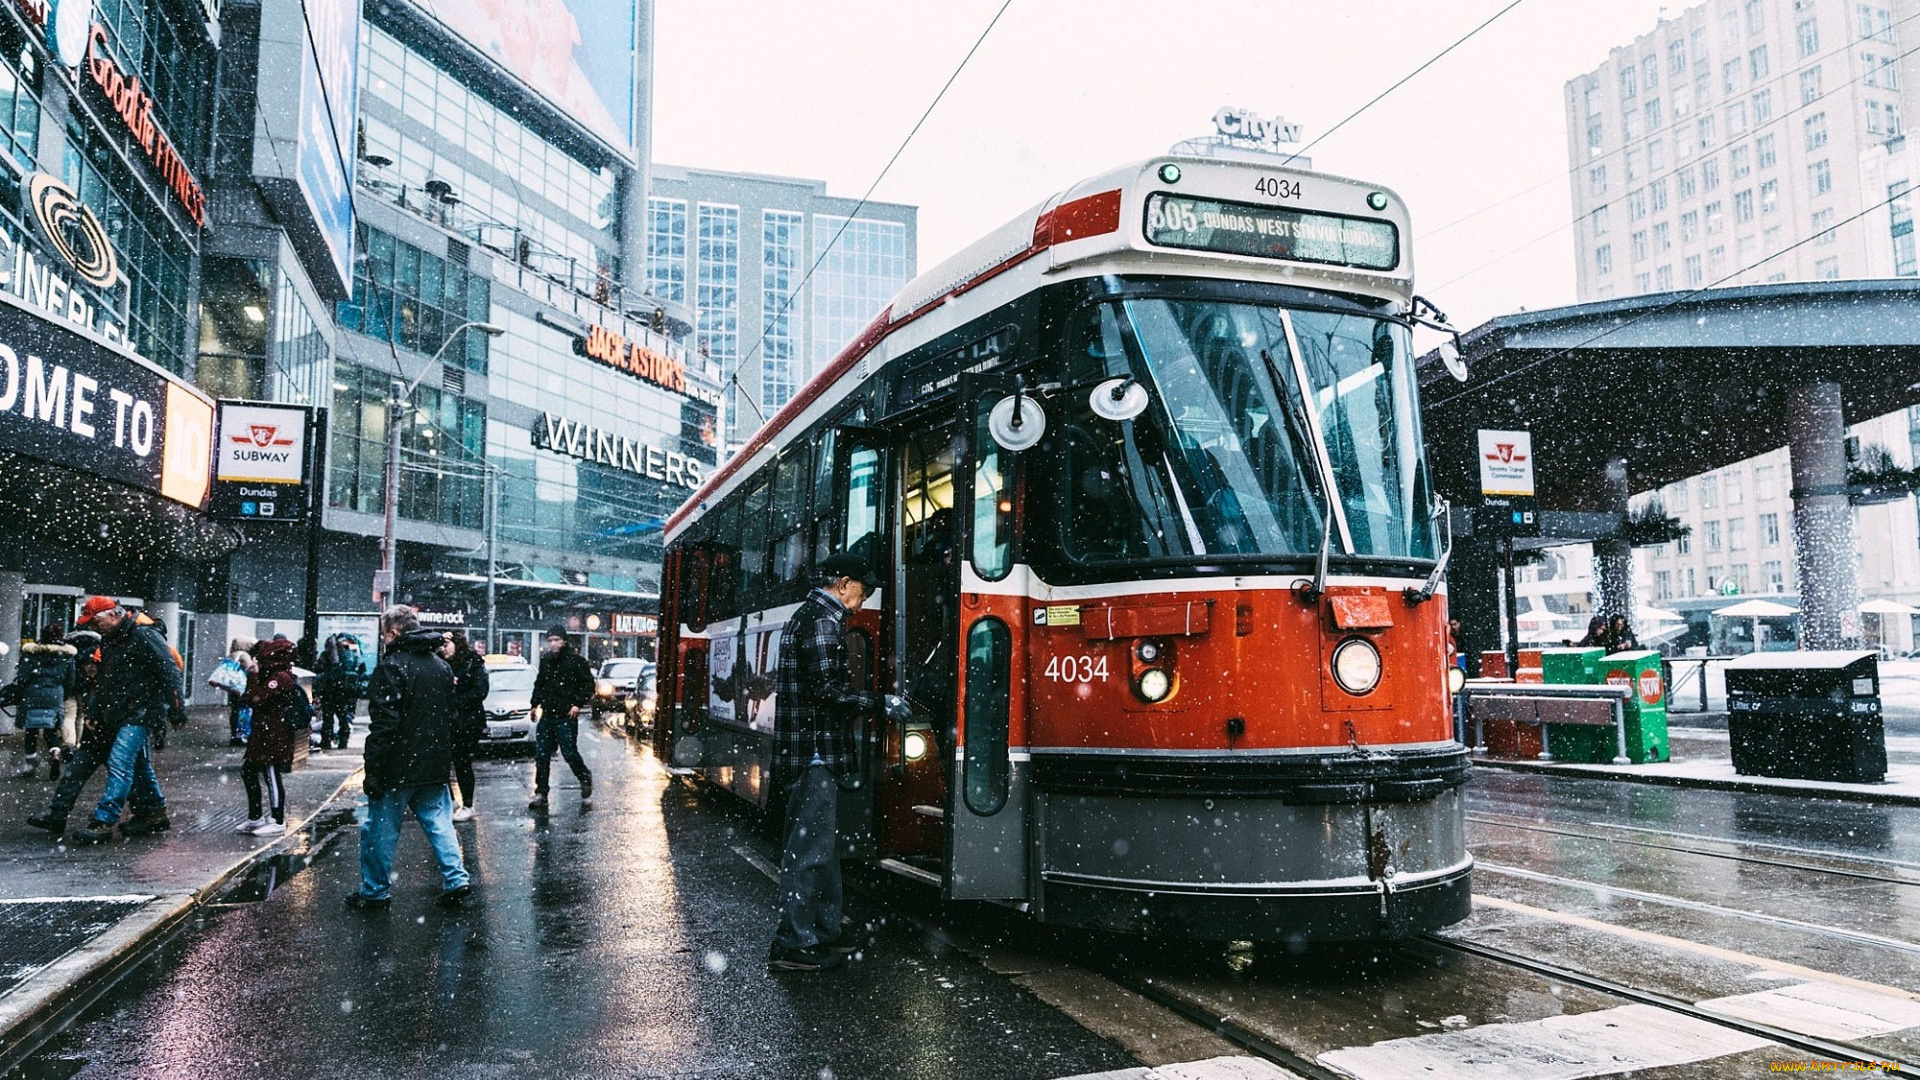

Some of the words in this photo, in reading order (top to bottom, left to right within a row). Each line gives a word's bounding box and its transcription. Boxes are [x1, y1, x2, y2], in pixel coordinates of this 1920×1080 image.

[1215, 106, 1304, 145] Citytv
[155, 133, 206, 227] FITNESS
[1255, 177, 1301, 199] 4034
[1203, 212, 1255, 233] DUNDAS
[1256, 218, 1290, 238] WEST
[586, 324, 626, 368] JACK
[629, 342, 685, 392] ASTOR'S
[110, 388, 152, 456] TO
[233, 450, 289, 462] SUBWAY
[544, 411, 702, 490] WINNERS
[240, 487, 277, 497] Dundas
[1485, 498, 1509, 506] Dundas
[1044, 655, 1109, 682] 4034
